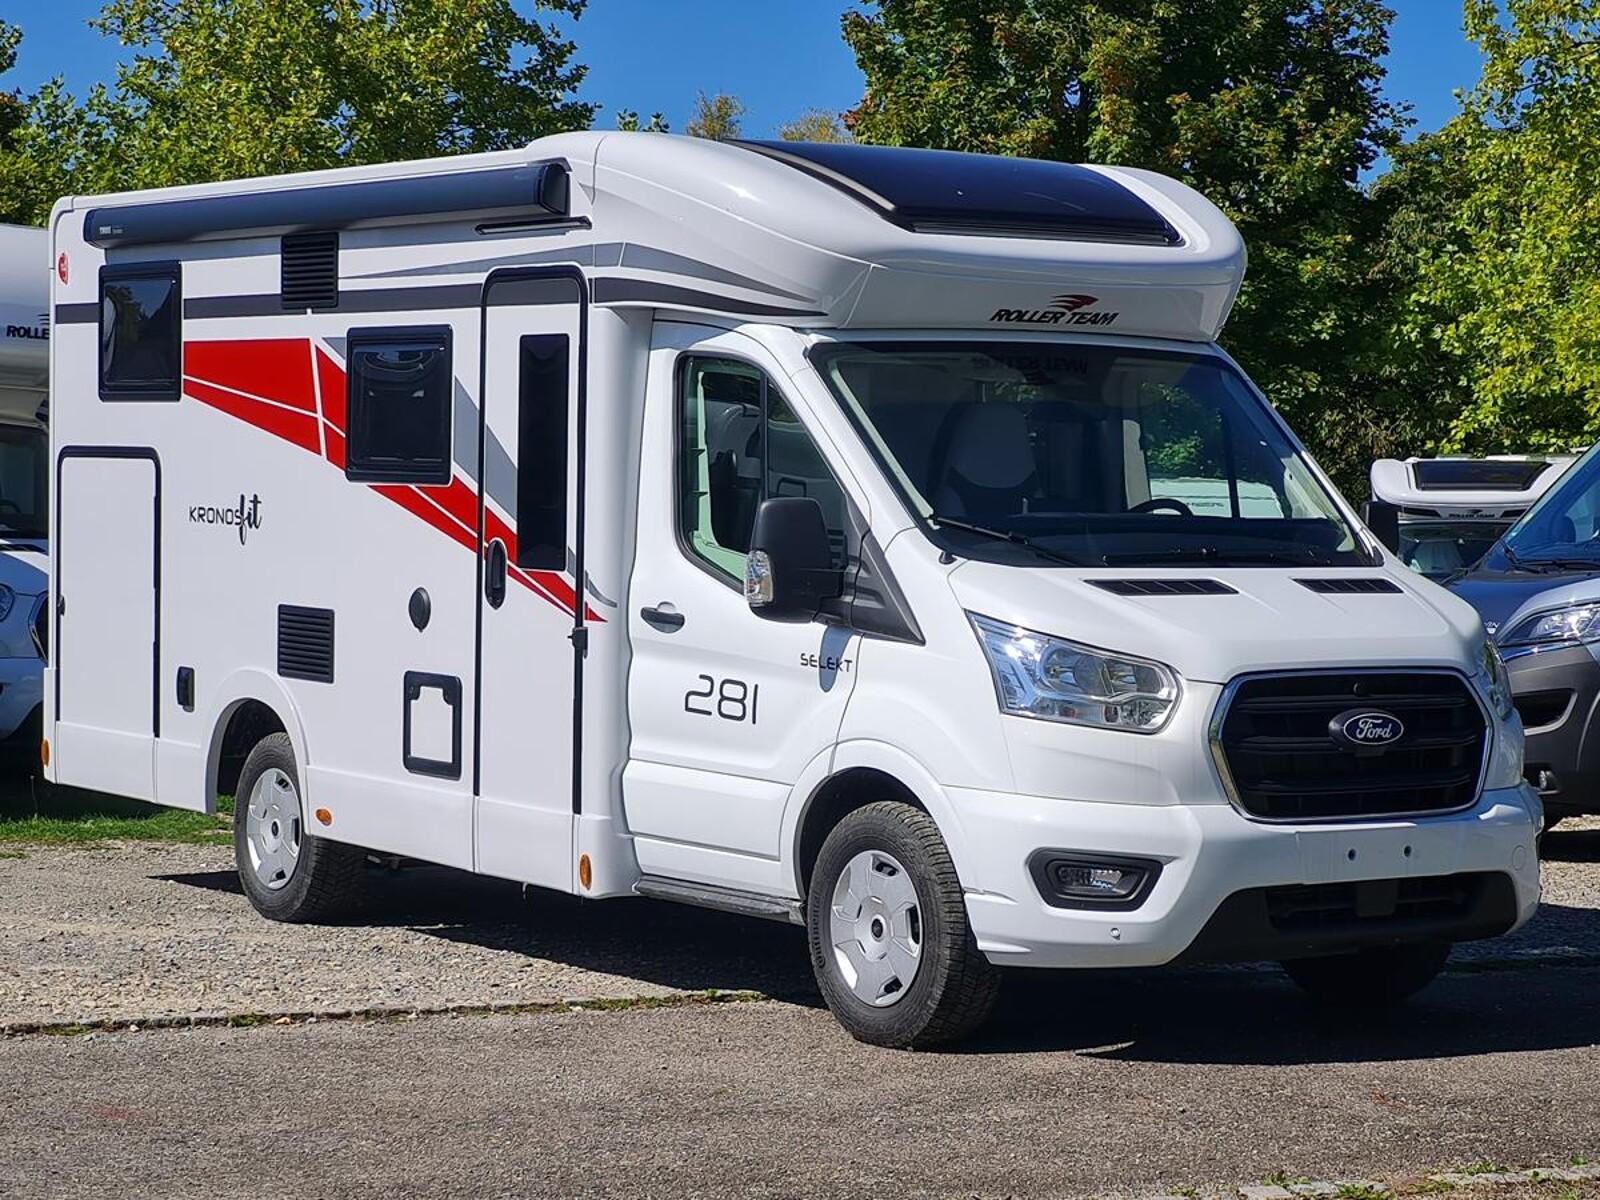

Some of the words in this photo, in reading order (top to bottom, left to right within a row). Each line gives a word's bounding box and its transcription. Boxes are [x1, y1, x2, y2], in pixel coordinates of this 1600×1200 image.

[990, 309, 1066, 324] ROLLER
[1066, 311, 1120, 325] TEAM
[800, 653, 853, 673] SELEKT
[684, 674, 759, 725] 281
[1356, 718, 1393, 739] Ford
